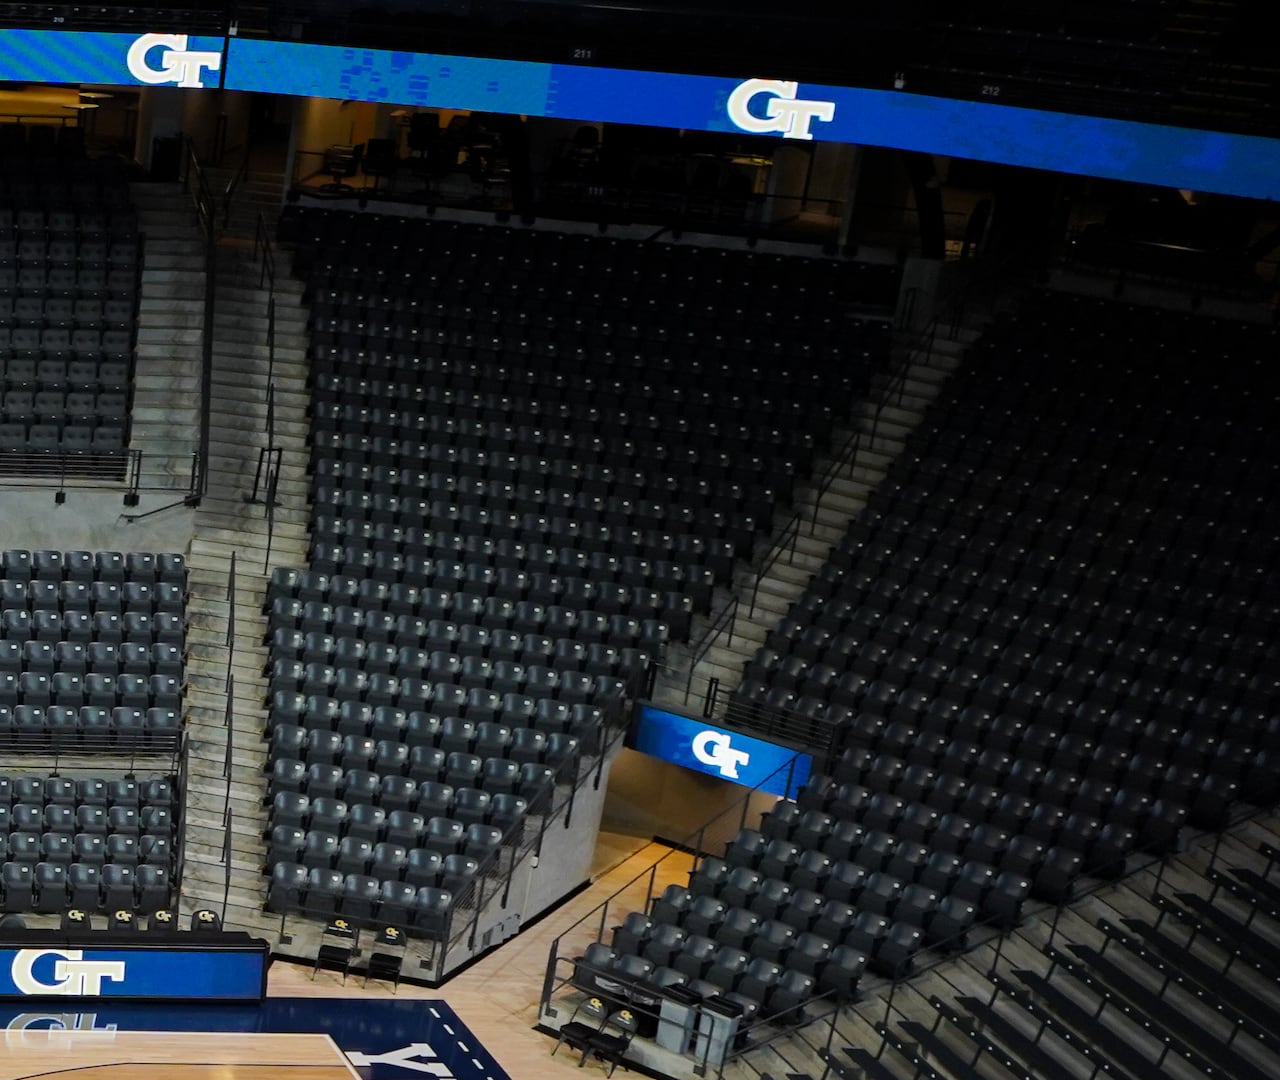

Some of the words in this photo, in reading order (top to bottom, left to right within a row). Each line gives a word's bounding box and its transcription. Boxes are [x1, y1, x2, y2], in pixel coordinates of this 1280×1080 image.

[127, 33, 221, 88] GT
[574, 48, 592, 59] 211
[728, 79, 836, 140] GT
[981, 85, 1000, 97] 212
[692, 730, 750, 779] GT
[11, 949, 125, 995] GT
